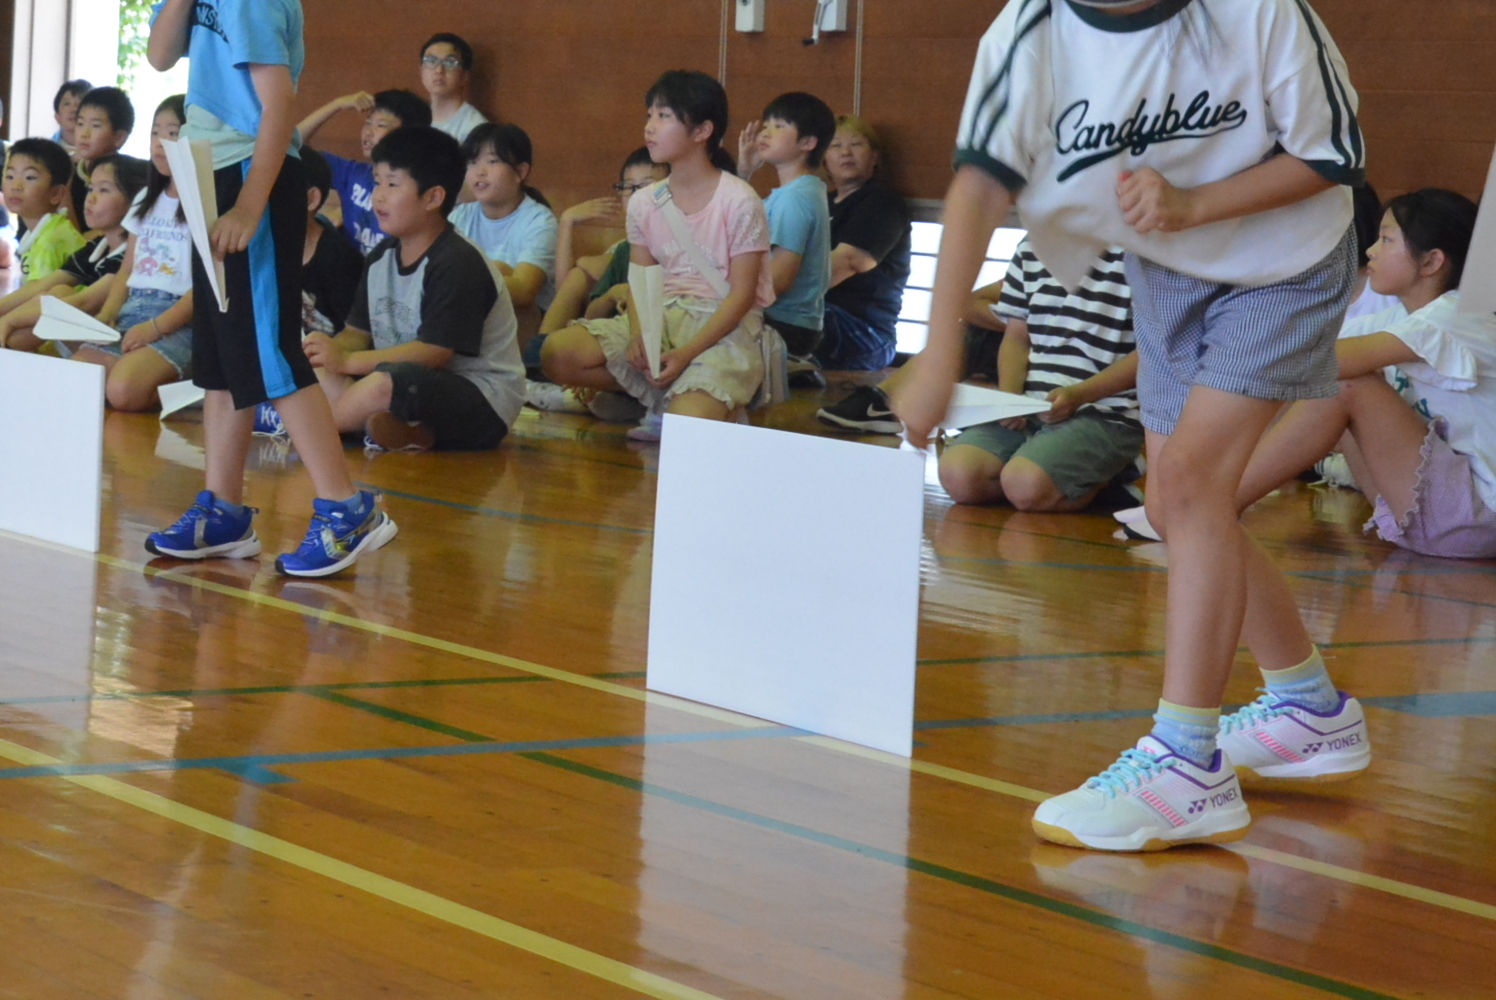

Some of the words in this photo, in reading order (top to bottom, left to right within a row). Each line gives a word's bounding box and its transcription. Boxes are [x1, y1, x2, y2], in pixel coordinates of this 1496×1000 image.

[1055, 89, 1248, 158] Candyblue
[1326, 731, 1363, 752] YONEX
[1210, 787, 1240, 809] YONEX
